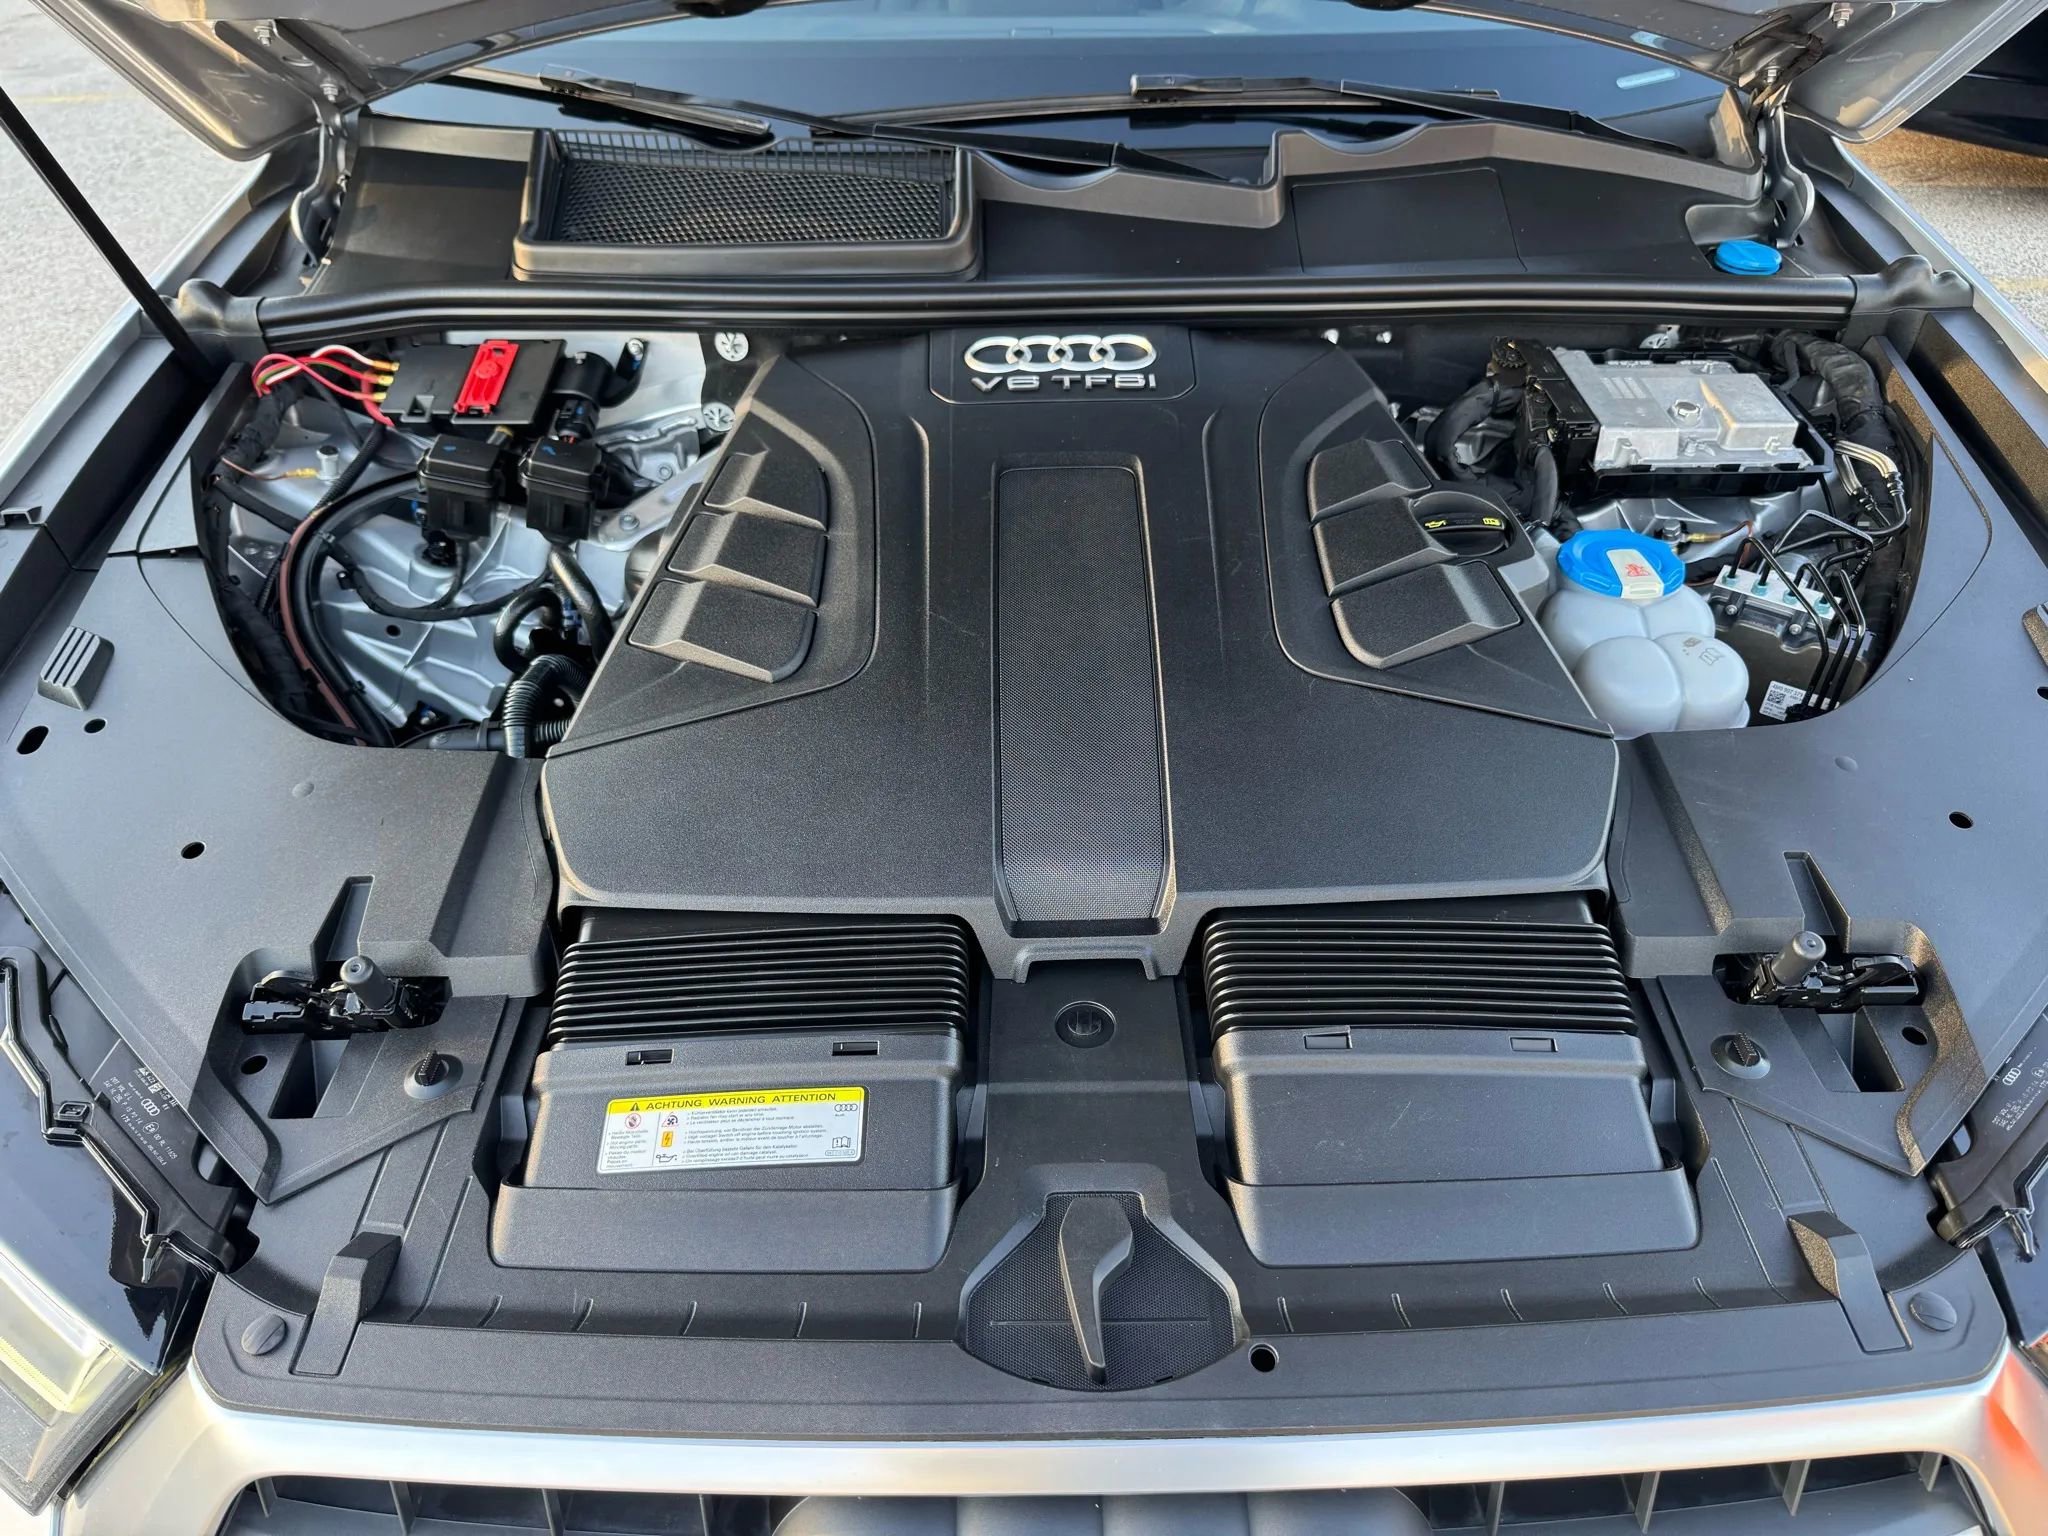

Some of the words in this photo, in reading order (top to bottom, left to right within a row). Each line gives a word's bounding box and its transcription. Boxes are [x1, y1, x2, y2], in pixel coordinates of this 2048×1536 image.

[971, 374, 1040, 392] V6
[1051, 373, 1156, 391] TFSI
[646, 1100, 703, 1110] ACHTUNG
[709, 1096, 766, 1106] WARNING
[772, 1092, 836, 1103] ATTENTION
